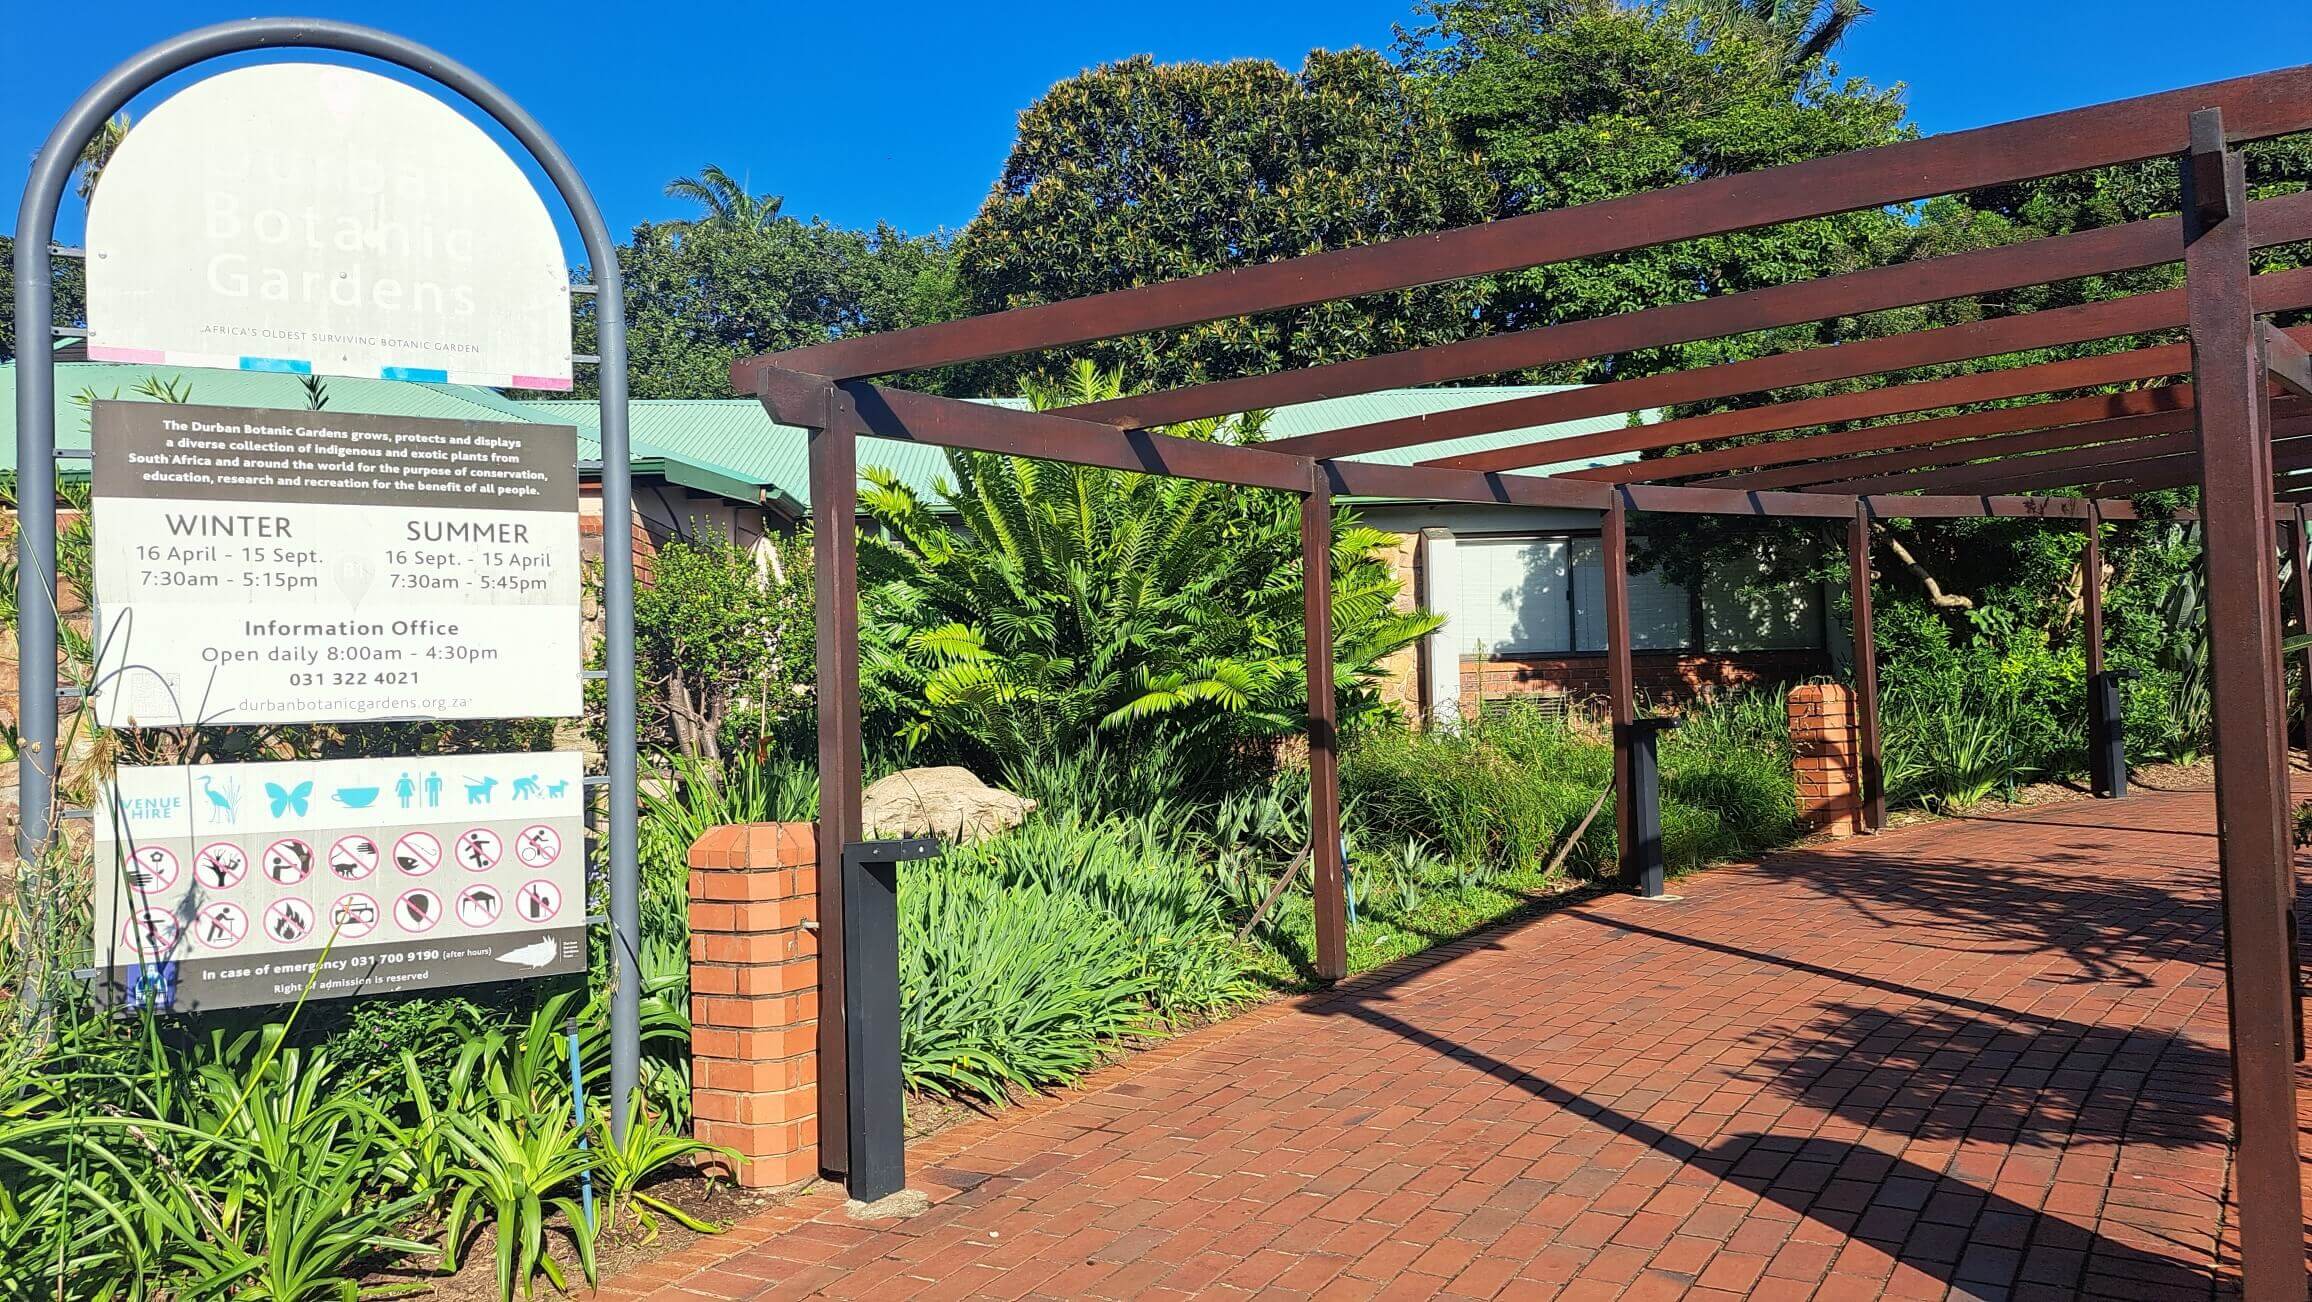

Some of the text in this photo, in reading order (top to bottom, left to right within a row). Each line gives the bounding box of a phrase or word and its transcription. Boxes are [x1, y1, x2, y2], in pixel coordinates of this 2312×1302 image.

[206, 192, 473, 263] Botanic
[207, 253, 475, 315] Gardens
[204, 324, 480, 353] AFRICA'S OLDEST SURVIVING BOTANIC GARDEN
[162, 419, 522, 450] The Durban Botanic Gardens grows, protects and displays
[165, 437, 520, 466] a diverse collection of indigenous and exotic plants from
[128, 452, 549, 482] South Africa and around the world for the purpose of conservation,
[142, 470, 540, 498] education, research and recreation for the benefit of all people.
[164, 513, 293, 538] WINTER
[406, 520, 529, 544] SUMMER
[136, 545, 161, 561] 16
[166, 545, 217, 566] April
[242, 547, 265, 562] 15
[273, 547, 323, 568] Sept.
[385, 550, 408, 565] 16
[414, 550, 461, 570] Sept.
[482, 552, 503, 567] 15
[508, 552, 551, 572] April
[141, 570, 218, 587] 7:30am
[243, 571, 318, 592] 5:15pm
[390, 573, 459, 589] 7:30am
[480, 575, 547, 594] 5:45pm
[245, 619, 459, 636] Information Office
[201, 646, 259, 665] Open
[267, 645, 319, 666] daily
[327, 646, 402, 661] 8:00am
[425, 645, 498, 664] 4:30pm
[289, 671, 418, 687] 031 322 4021
[119, 797, 182, 809] VENUE
[131, 807, 172, 819] HIRE
[202, 969, 216, 980] In
[220, 968, 251, 979] case
[255, 964, 270, 975] of
[350, 955, 375, 967] 031
[379, 952, 404, 964] 700
[407, 950, 440, 962] 9190
[442, 950, 465, 961] (after
[467, 946, 492, 958] hours)
[273, 982, 302, 995] Right
[319, 976, 372, 990] admission
[375, 975, 385, 985] is
[386, 970, 429, 983] reserved
